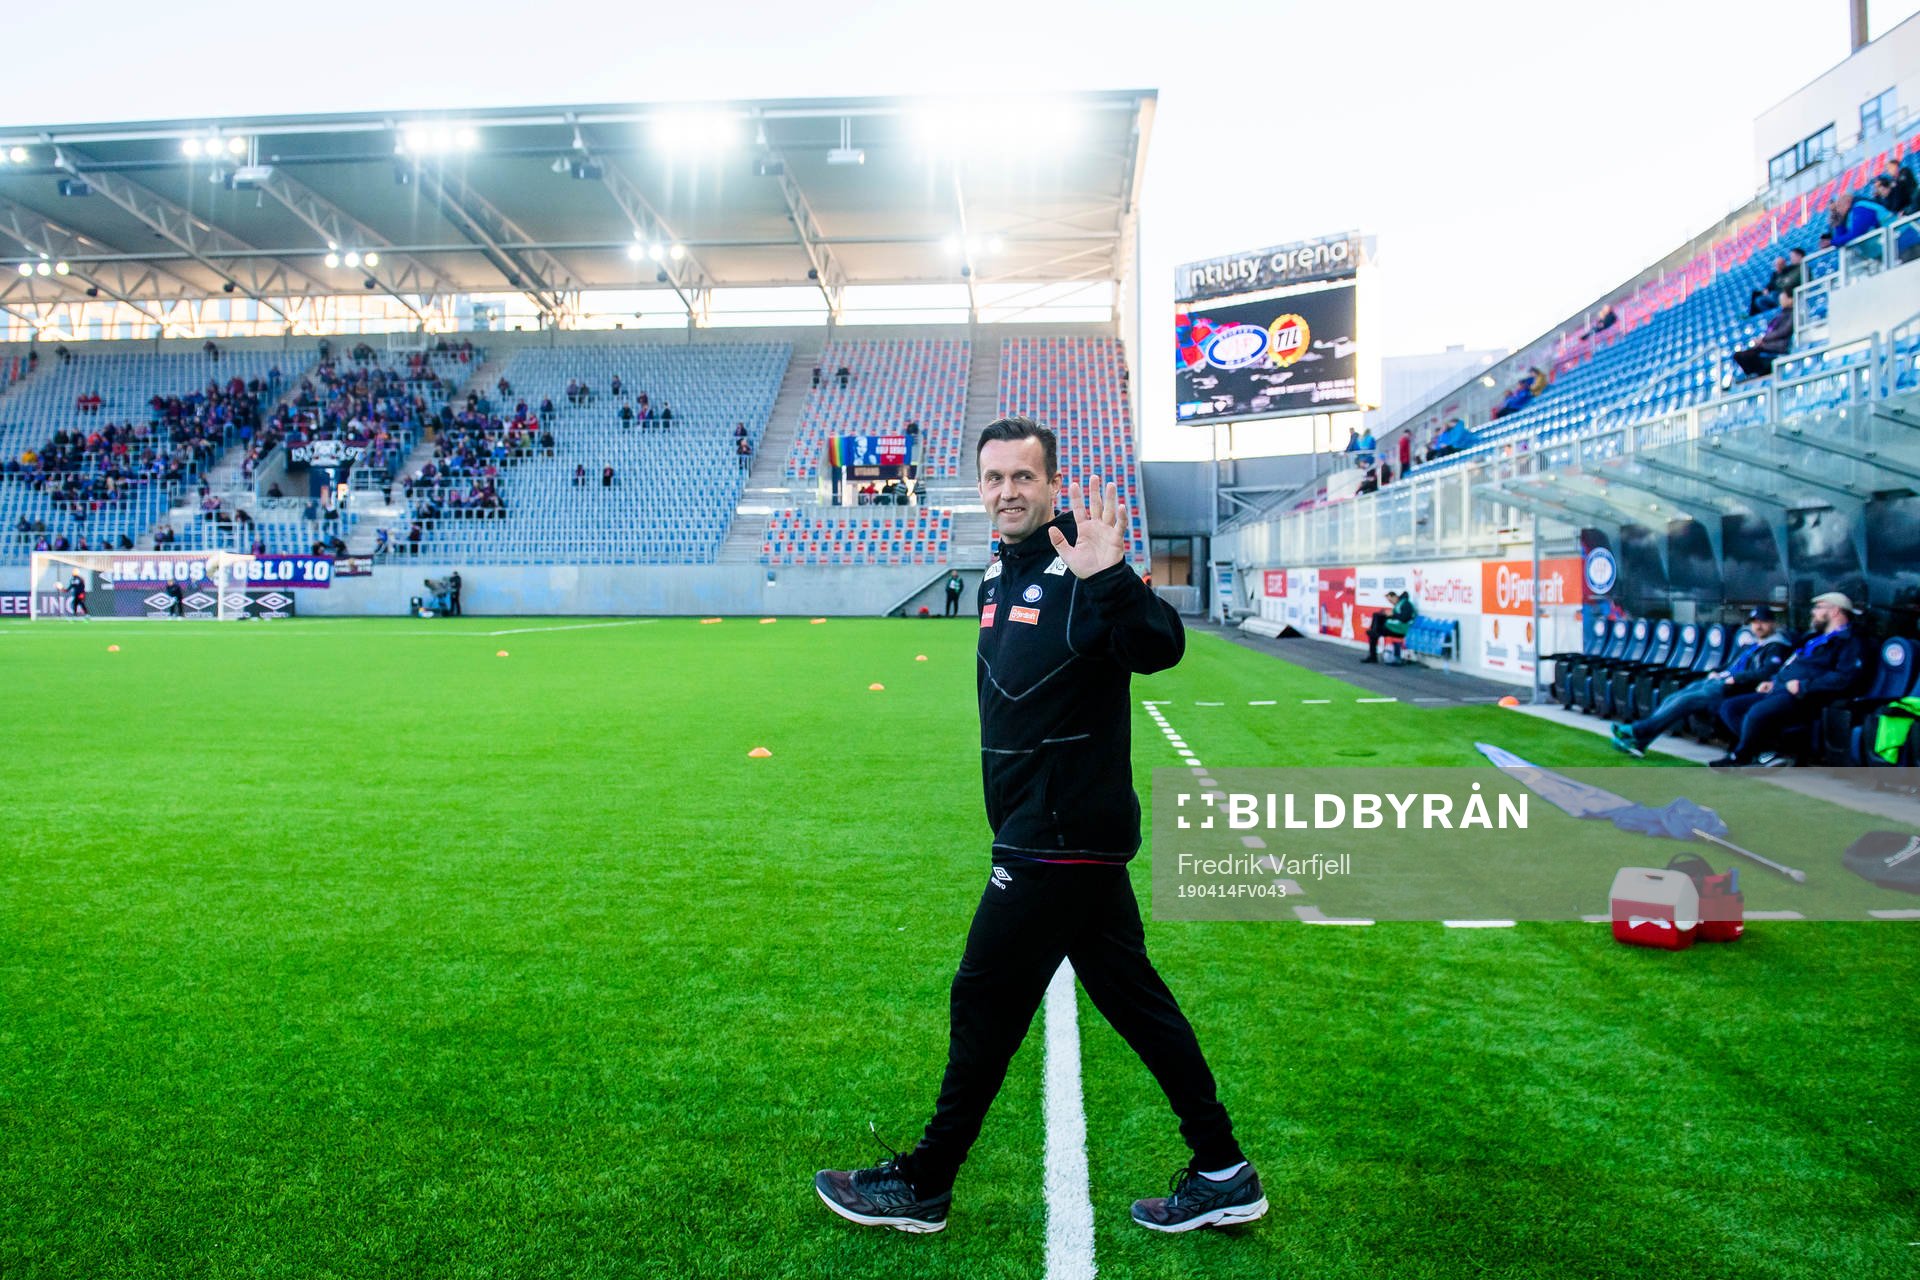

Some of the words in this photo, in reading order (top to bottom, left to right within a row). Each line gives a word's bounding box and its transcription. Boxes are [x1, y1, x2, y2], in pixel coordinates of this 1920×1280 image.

[1271, 241, 1348, 272] arena
[233, 560, 294, 580] OSLO
[297, 560, 330, 581] '10
